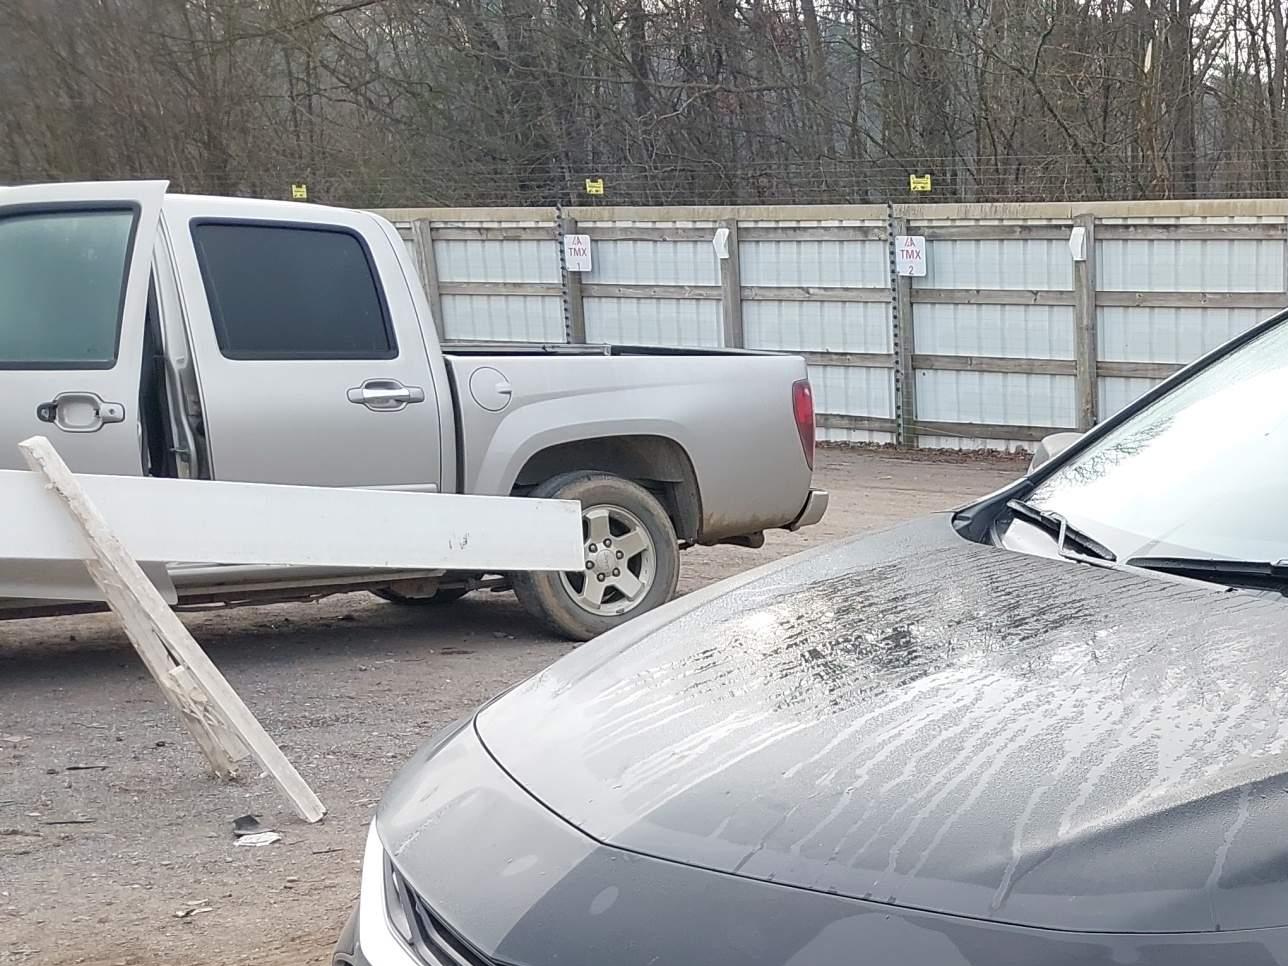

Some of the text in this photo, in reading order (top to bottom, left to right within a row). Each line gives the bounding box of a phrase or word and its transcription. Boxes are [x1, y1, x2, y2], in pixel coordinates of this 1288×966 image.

[568, 247, 587, 257] TMX
[900, 249, 922, 260] TMX
[908, 265, 914, 275] 2
